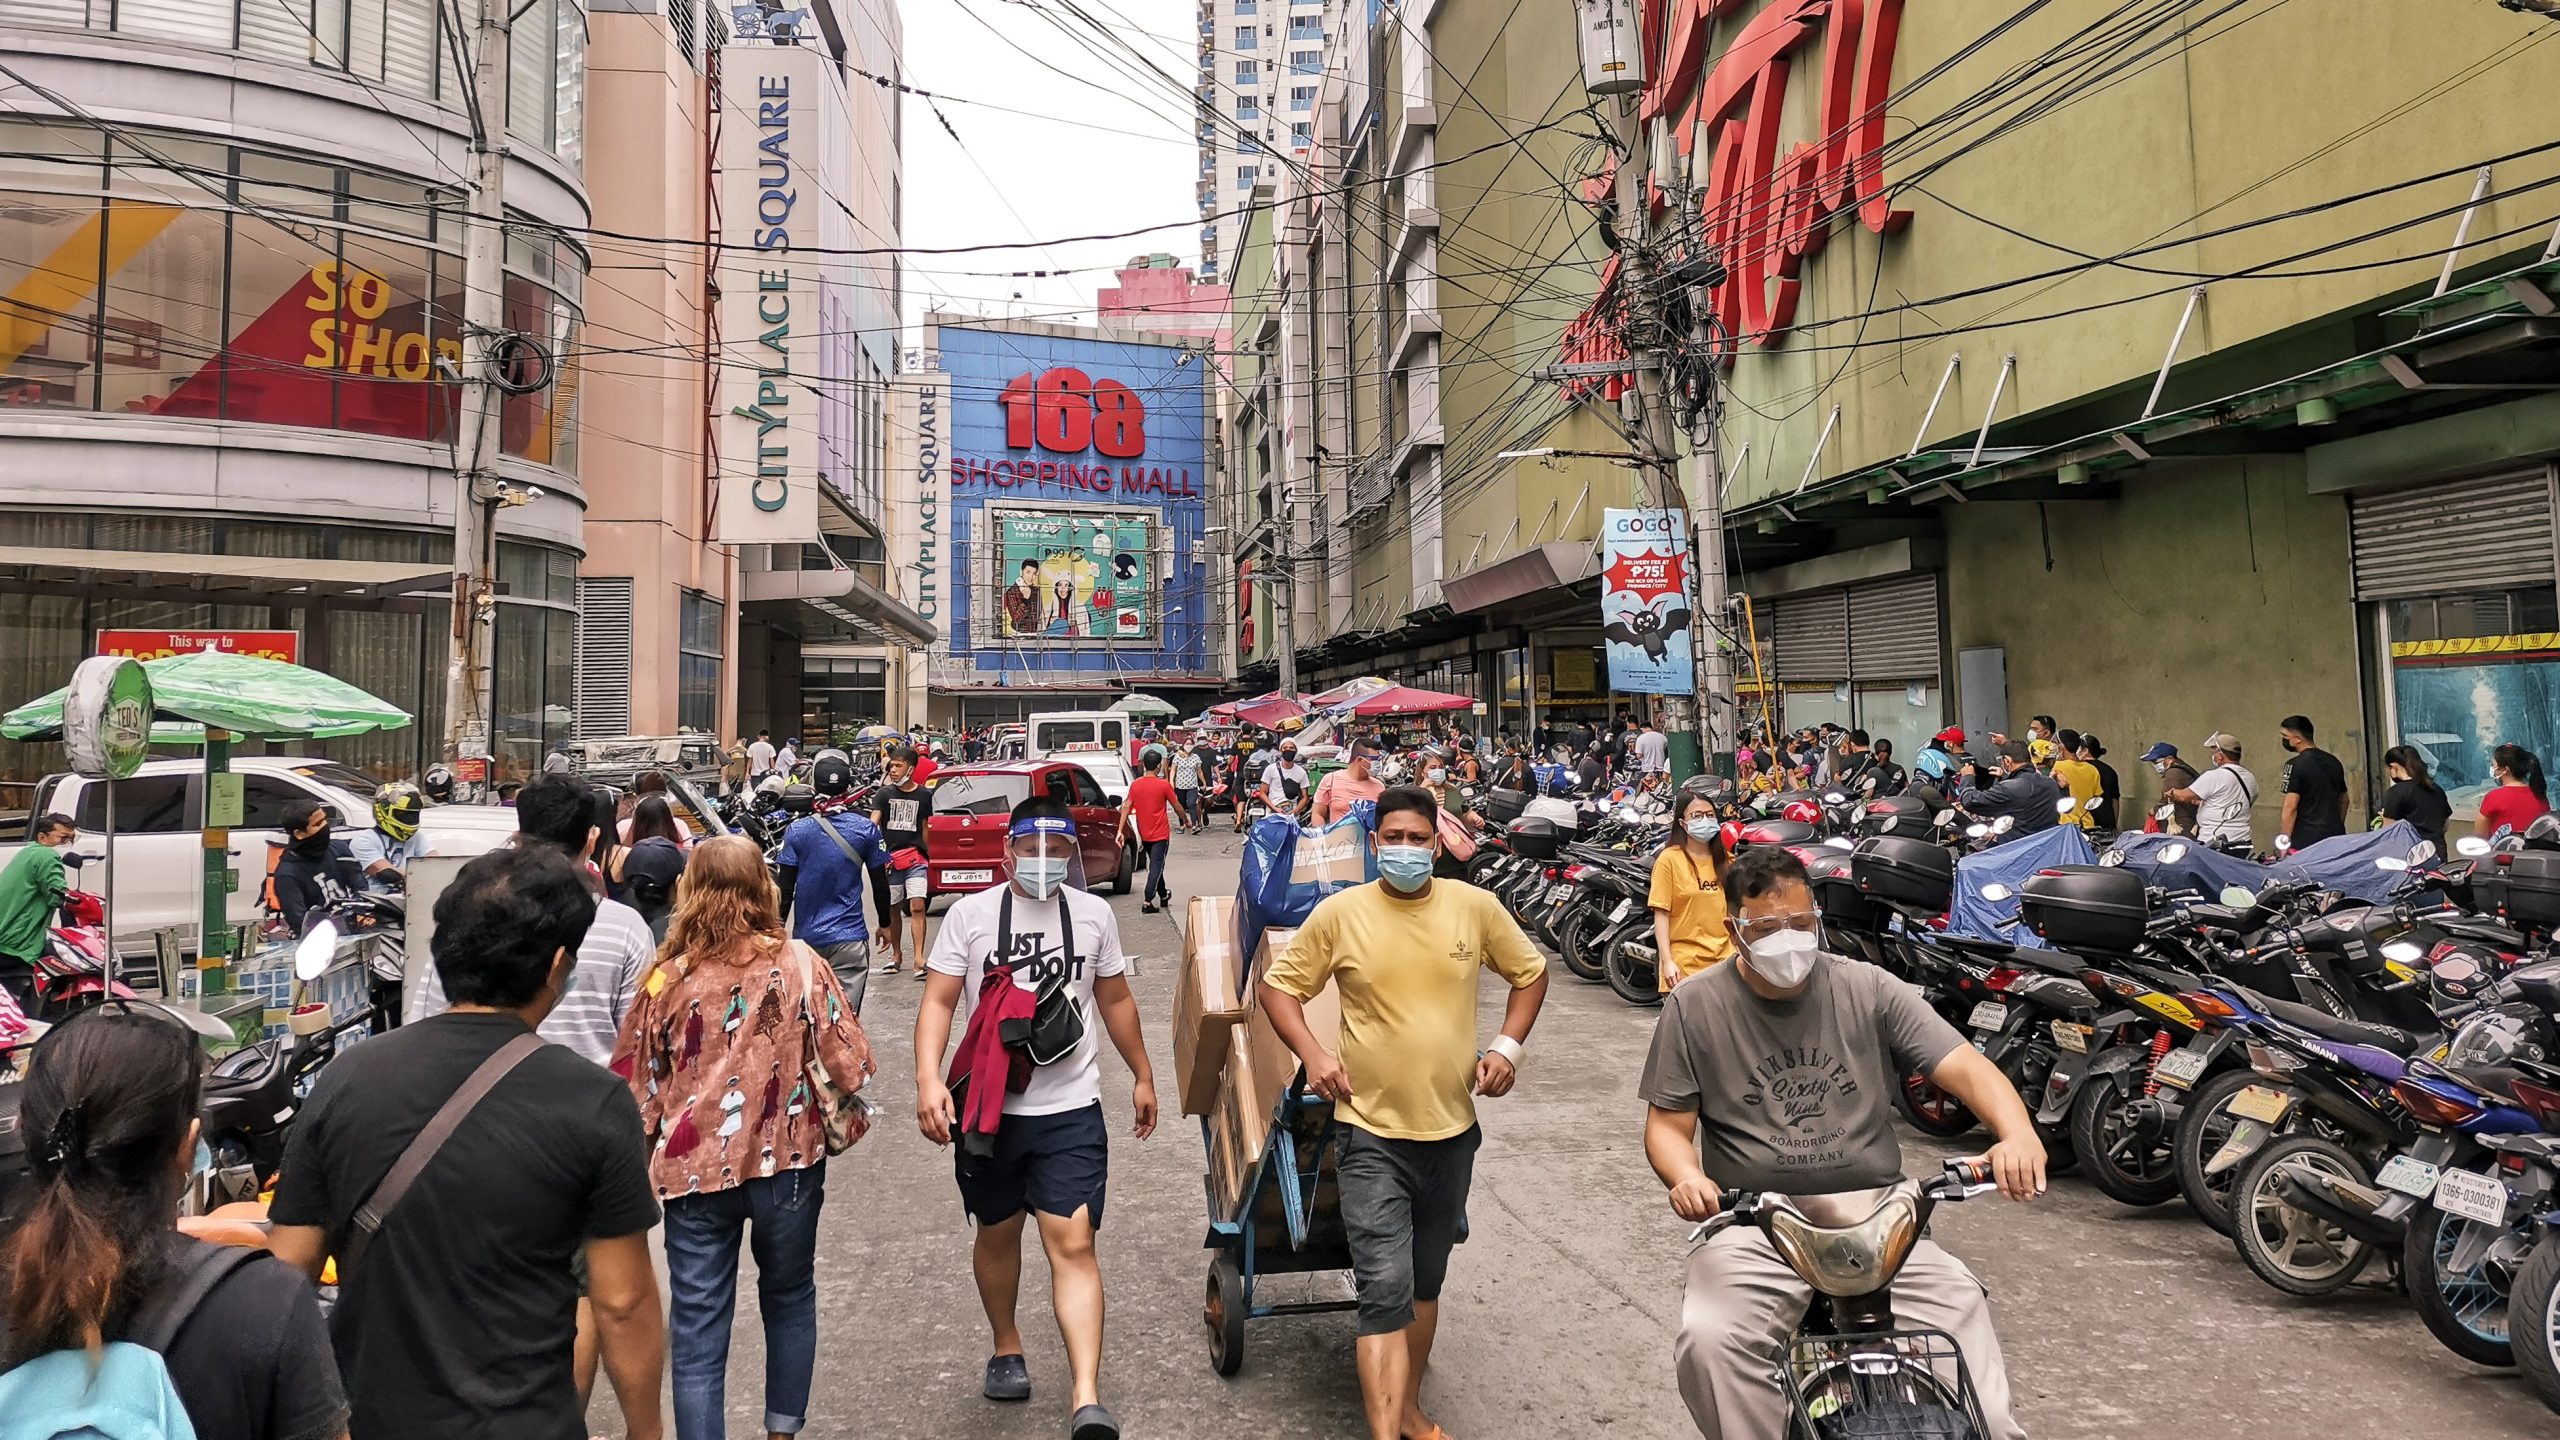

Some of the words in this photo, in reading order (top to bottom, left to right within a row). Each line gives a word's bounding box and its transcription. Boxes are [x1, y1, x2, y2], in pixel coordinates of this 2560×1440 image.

[754, 75, 797, 254] SQUARE
[305, 261, 391, 320] SO
[732, 270, 790, 512] CITYPLACE
[999, 367, 1146, 458] 168
[917, 385, 940, 485] SQUARE
[950, 457, 1113, 492] SHOPPING
[1121, 466, 1198, 495] MALL
[1616, 518, 1672, 533] GOGO
[907, 490, 938, 621] CITYPLACE
[168, 635, 192, 648] This
[221, 635, 234, 648] to
[1698, 879, 1719, 891] Lee
[993, 931, 1045, 957] UST
[2300, 1038, 2339, 1064] YAMAHA
[1771, 1078, 1831, 1103] Sixty
[1769, 1126, 1846, 1149] BOARDRIDING
[1776, 1150, 1845, 1166] COMPANY
